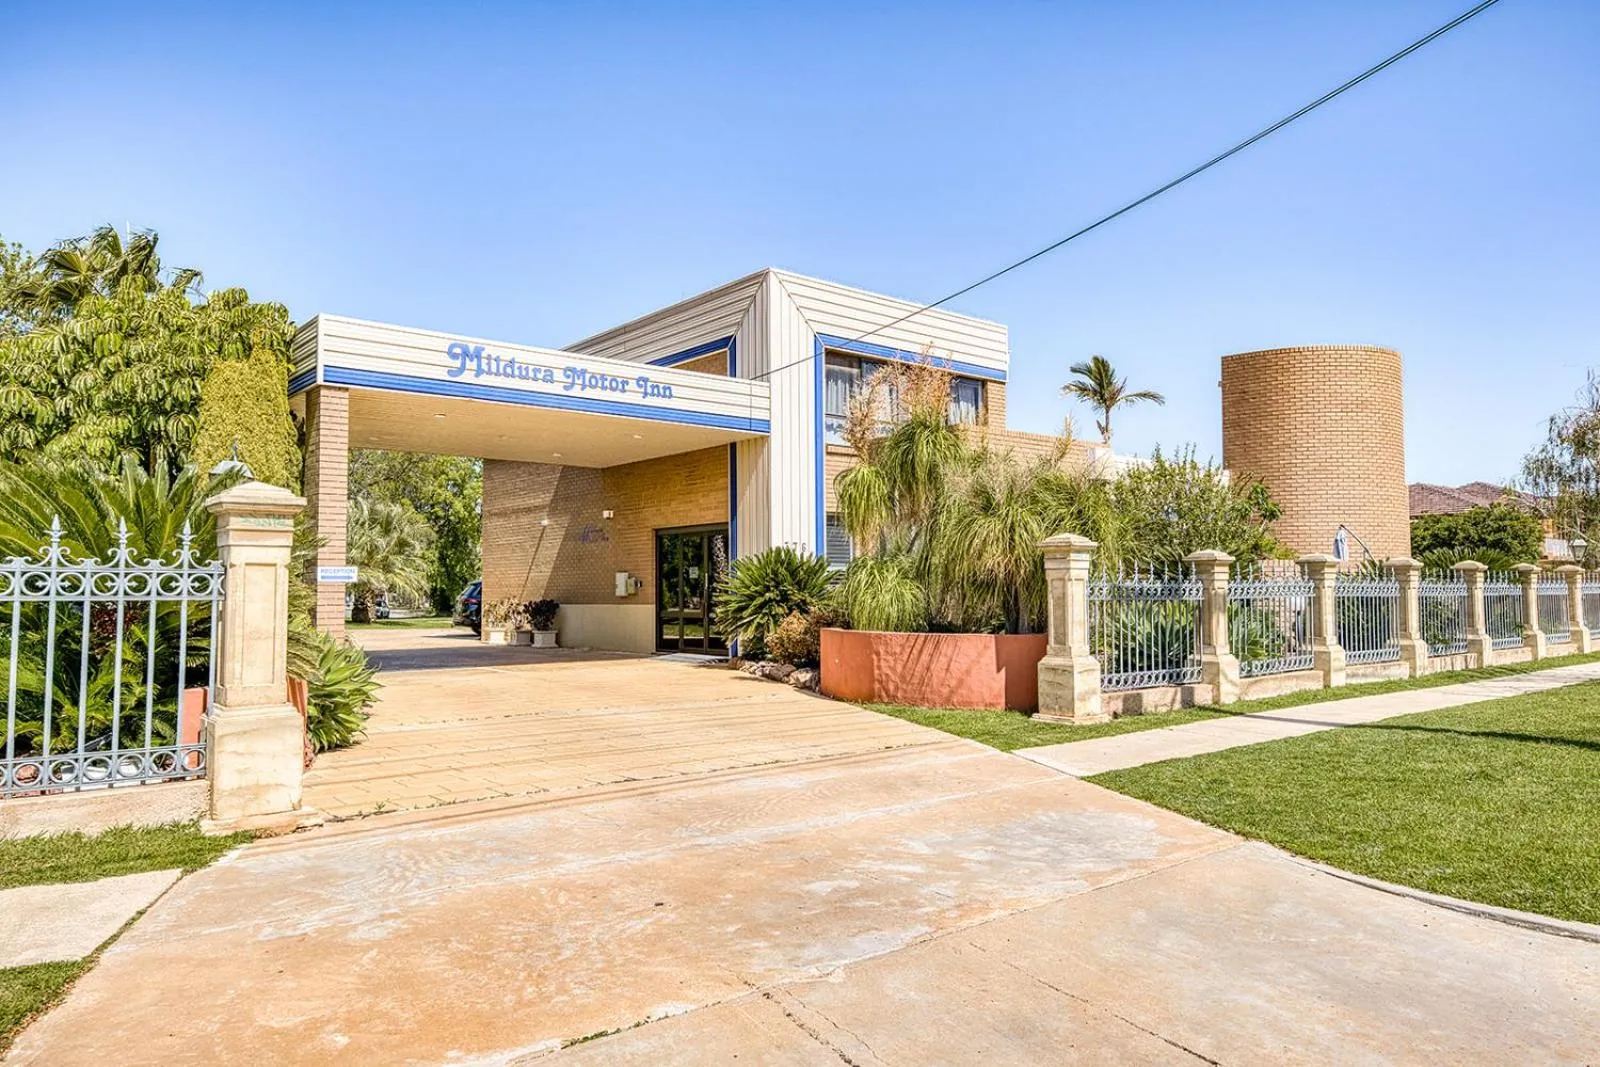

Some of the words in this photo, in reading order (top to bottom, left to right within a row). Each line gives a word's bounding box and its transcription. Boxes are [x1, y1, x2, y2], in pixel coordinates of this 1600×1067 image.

[447, 342, 554, 383] Mildura
[563, 366, 629, 393] Motor
[635, 376, 673, 399] Inn
